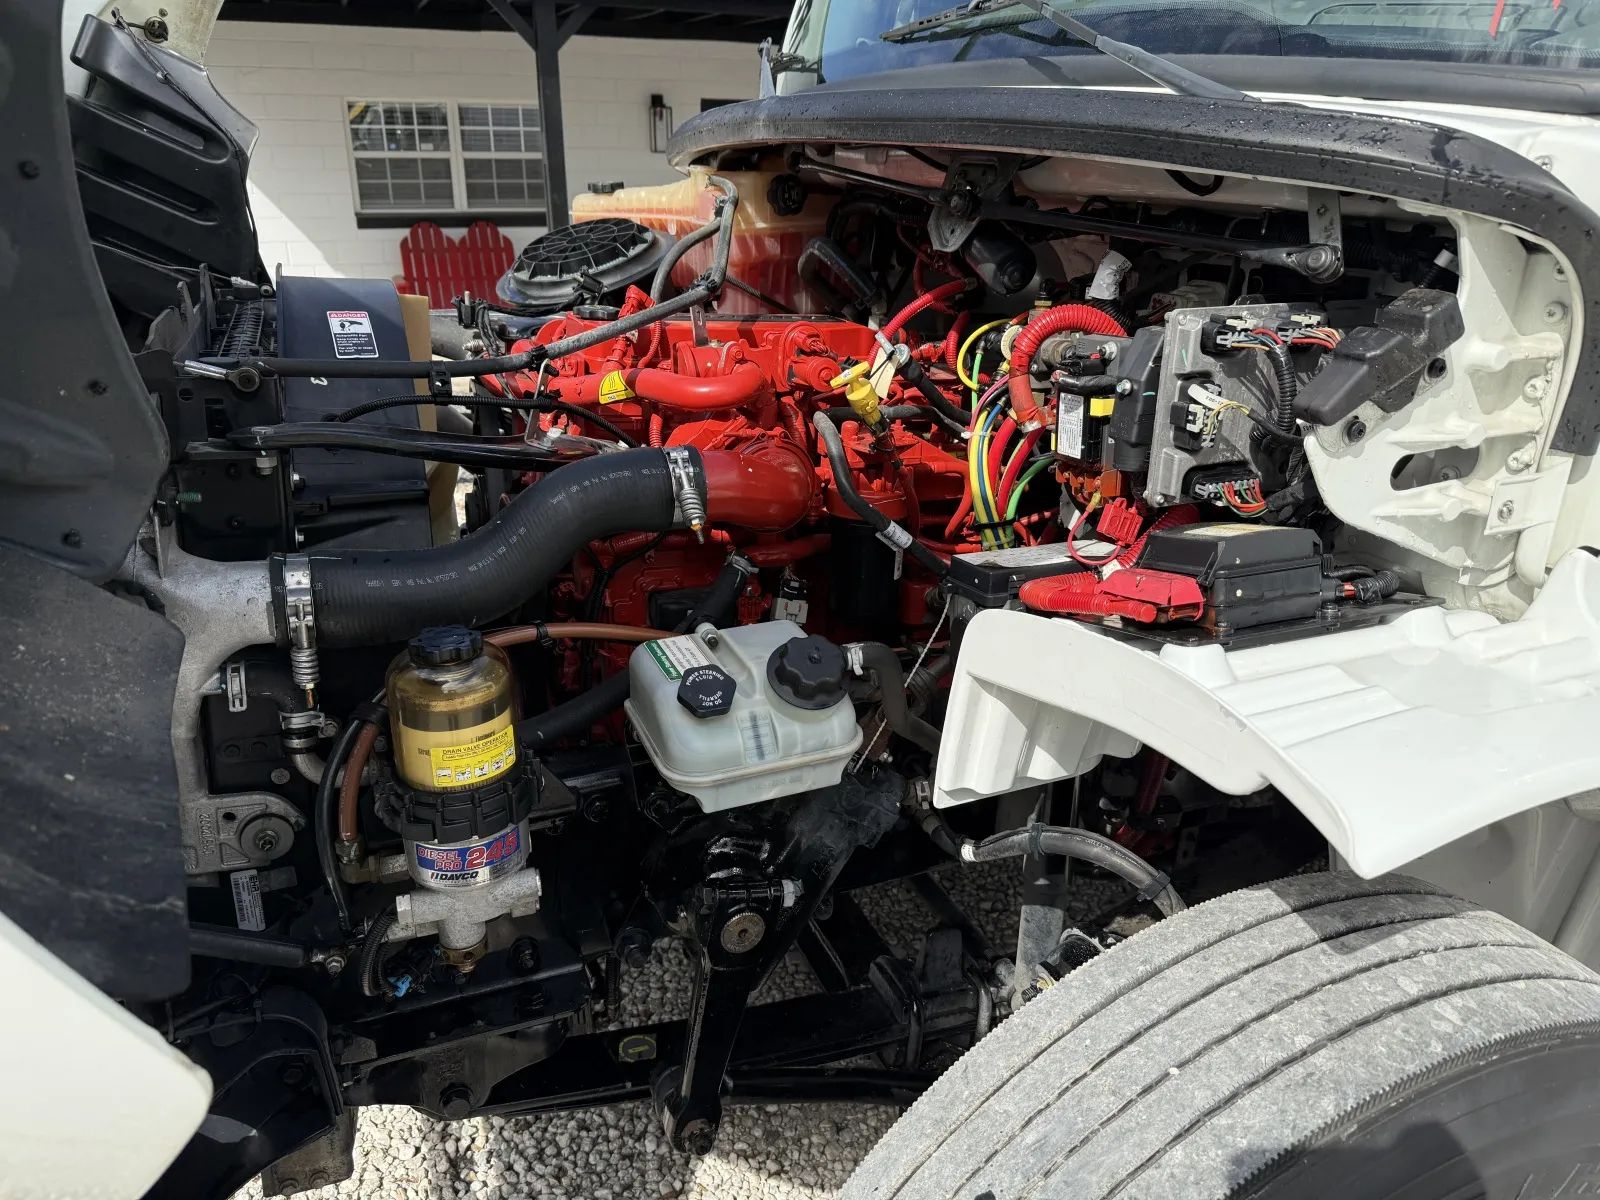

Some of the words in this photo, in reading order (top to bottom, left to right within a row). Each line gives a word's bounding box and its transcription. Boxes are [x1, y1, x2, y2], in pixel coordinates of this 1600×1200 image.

[686, 671, 699, 686] POWER
[695, 674, 713, 682] FLUID
[442, 747, 462, 755] DRAIN
[462, 742, 481, 752] VALVE
[417, 846, 462, 861] DIESEL
[464, 830, 518, 871] 245
[434, 860, 463, 871] PRO
[438, 871, 480, 881] DAVCO
